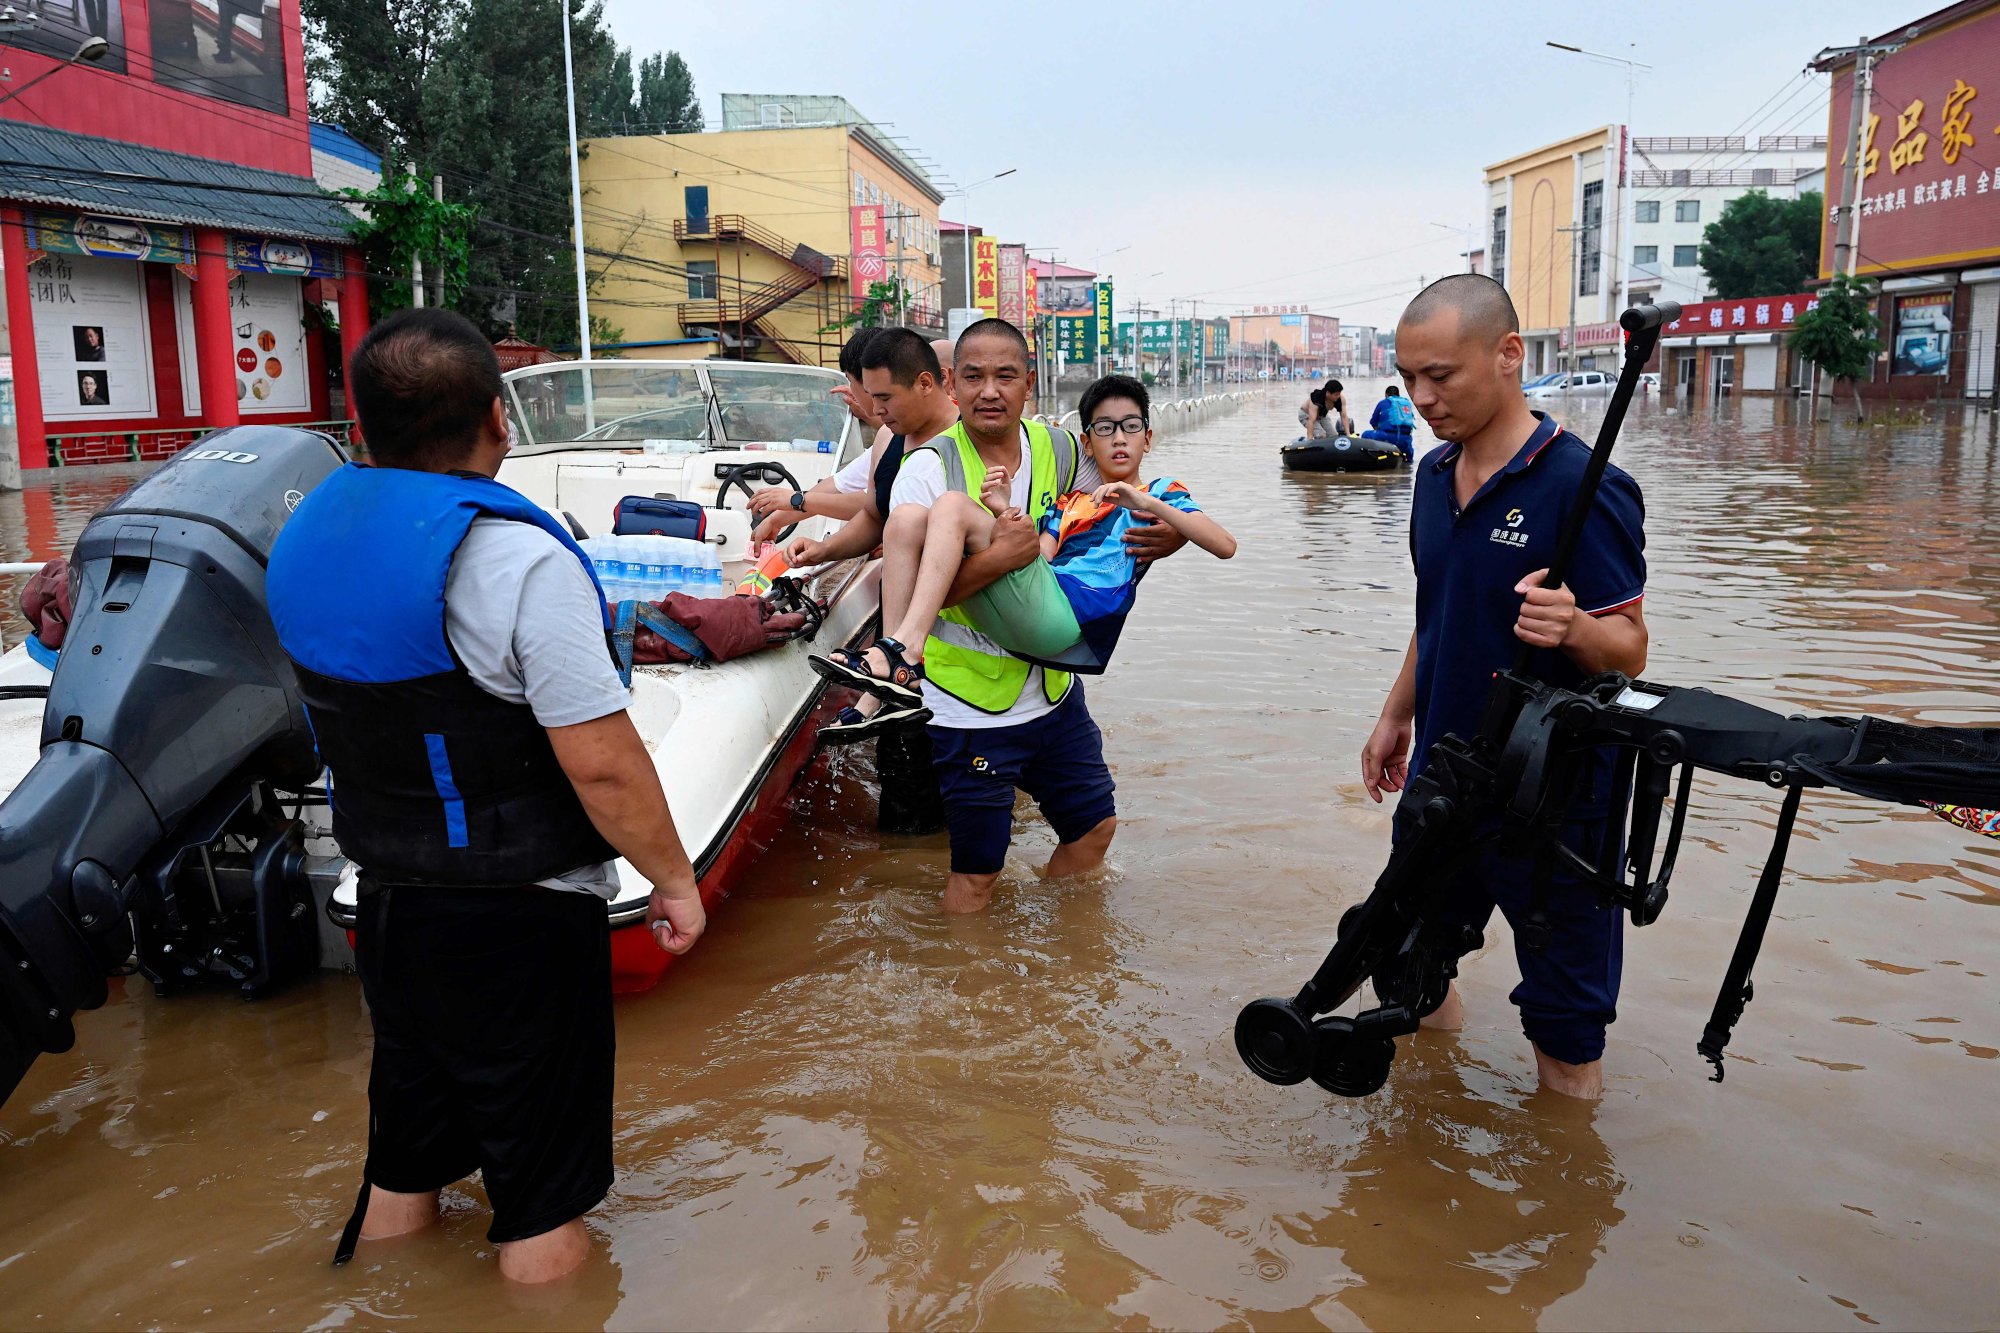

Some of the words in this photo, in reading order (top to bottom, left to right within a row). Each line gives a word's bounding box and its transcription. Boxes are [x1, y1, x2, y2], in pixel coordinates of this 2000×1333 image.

[1840, 79, 2000, 179] 名品家
[1914, 174, 1967, 206] 欧式家具
[29, 282, 76, 304] 团队
